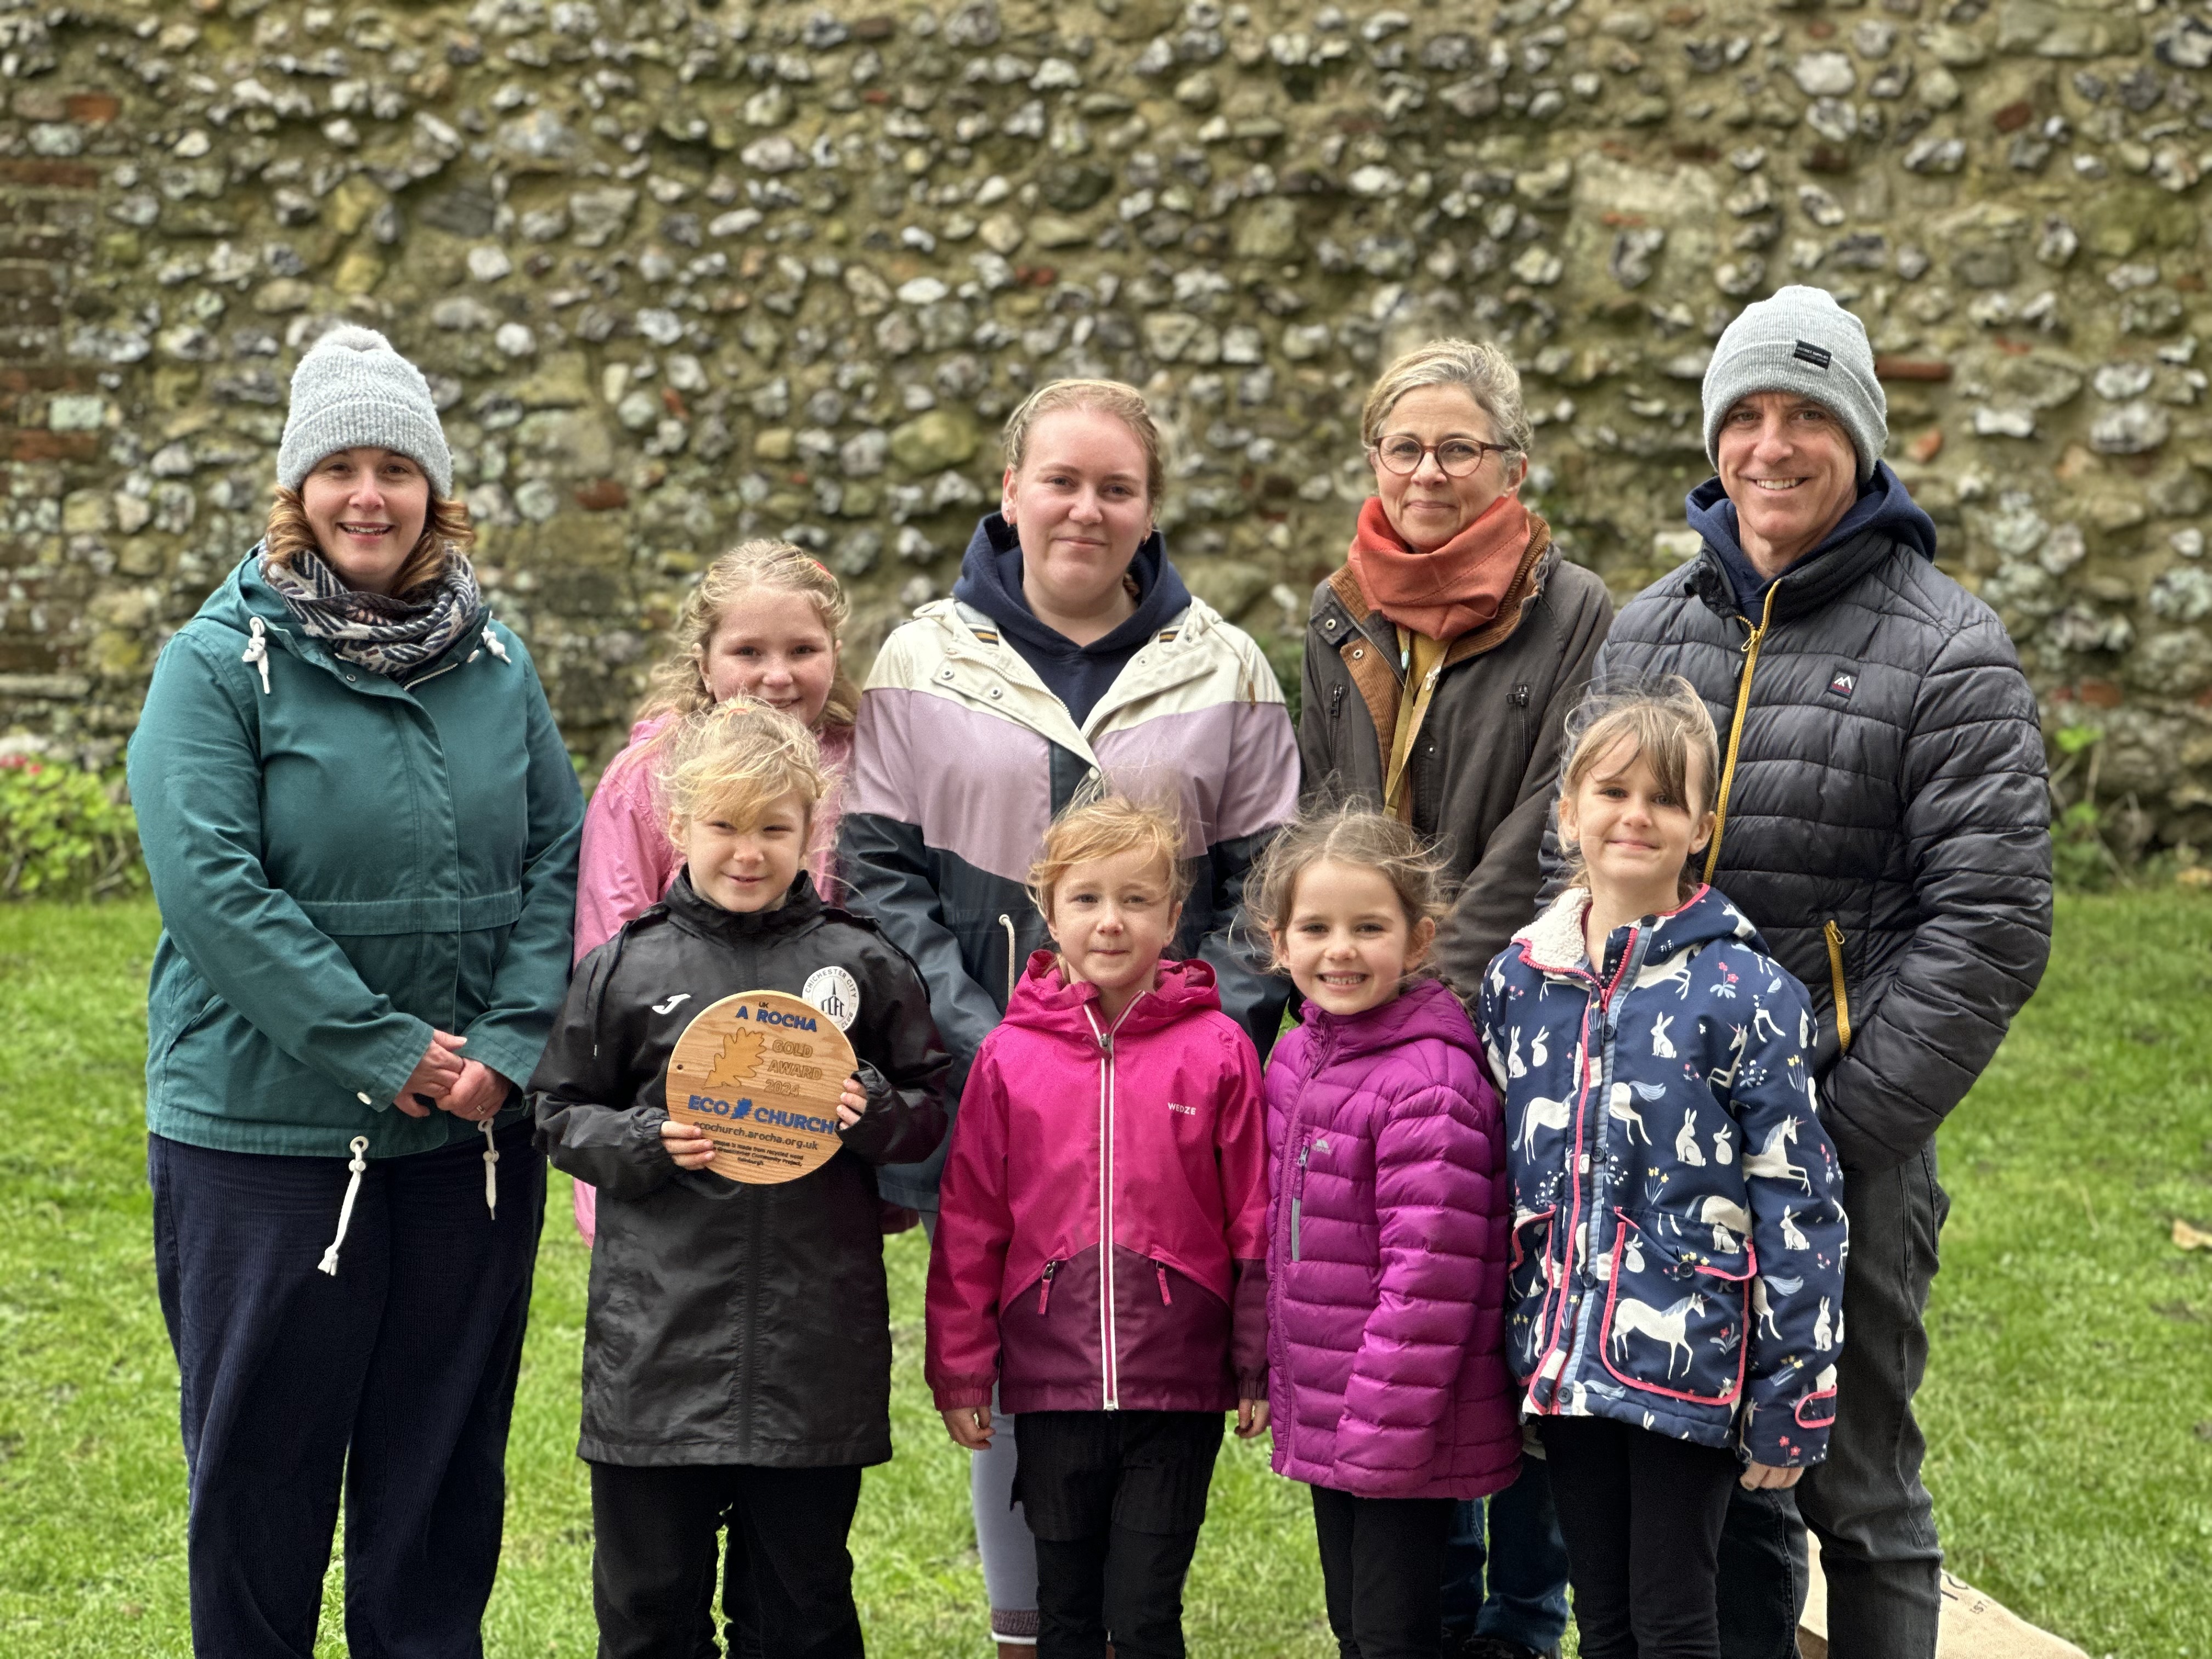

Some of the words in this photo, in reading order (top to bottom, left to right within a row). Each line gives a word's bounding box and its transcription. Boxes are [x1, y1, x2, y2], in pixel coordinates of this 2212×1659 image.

[805, 968, 847, 993] CHICHESTER
[847, 979, 857, 998] CITY
[736, 1005, 748, 1019] A
[756, 1009, 817, 1032] ROCHA
[841, 1012, 854, 1029] CLUB
[772, 1040, 813, 1058] GOLD
[767, 1059, 822, 1080] AWARD
[763, 1079, 800, 1097] 2024
[688, 1094, 729, 1115] ECO
[754, 1107, 835, 1135] CHURCH
[1167, 1102, 1196, 1115] WEDZE
